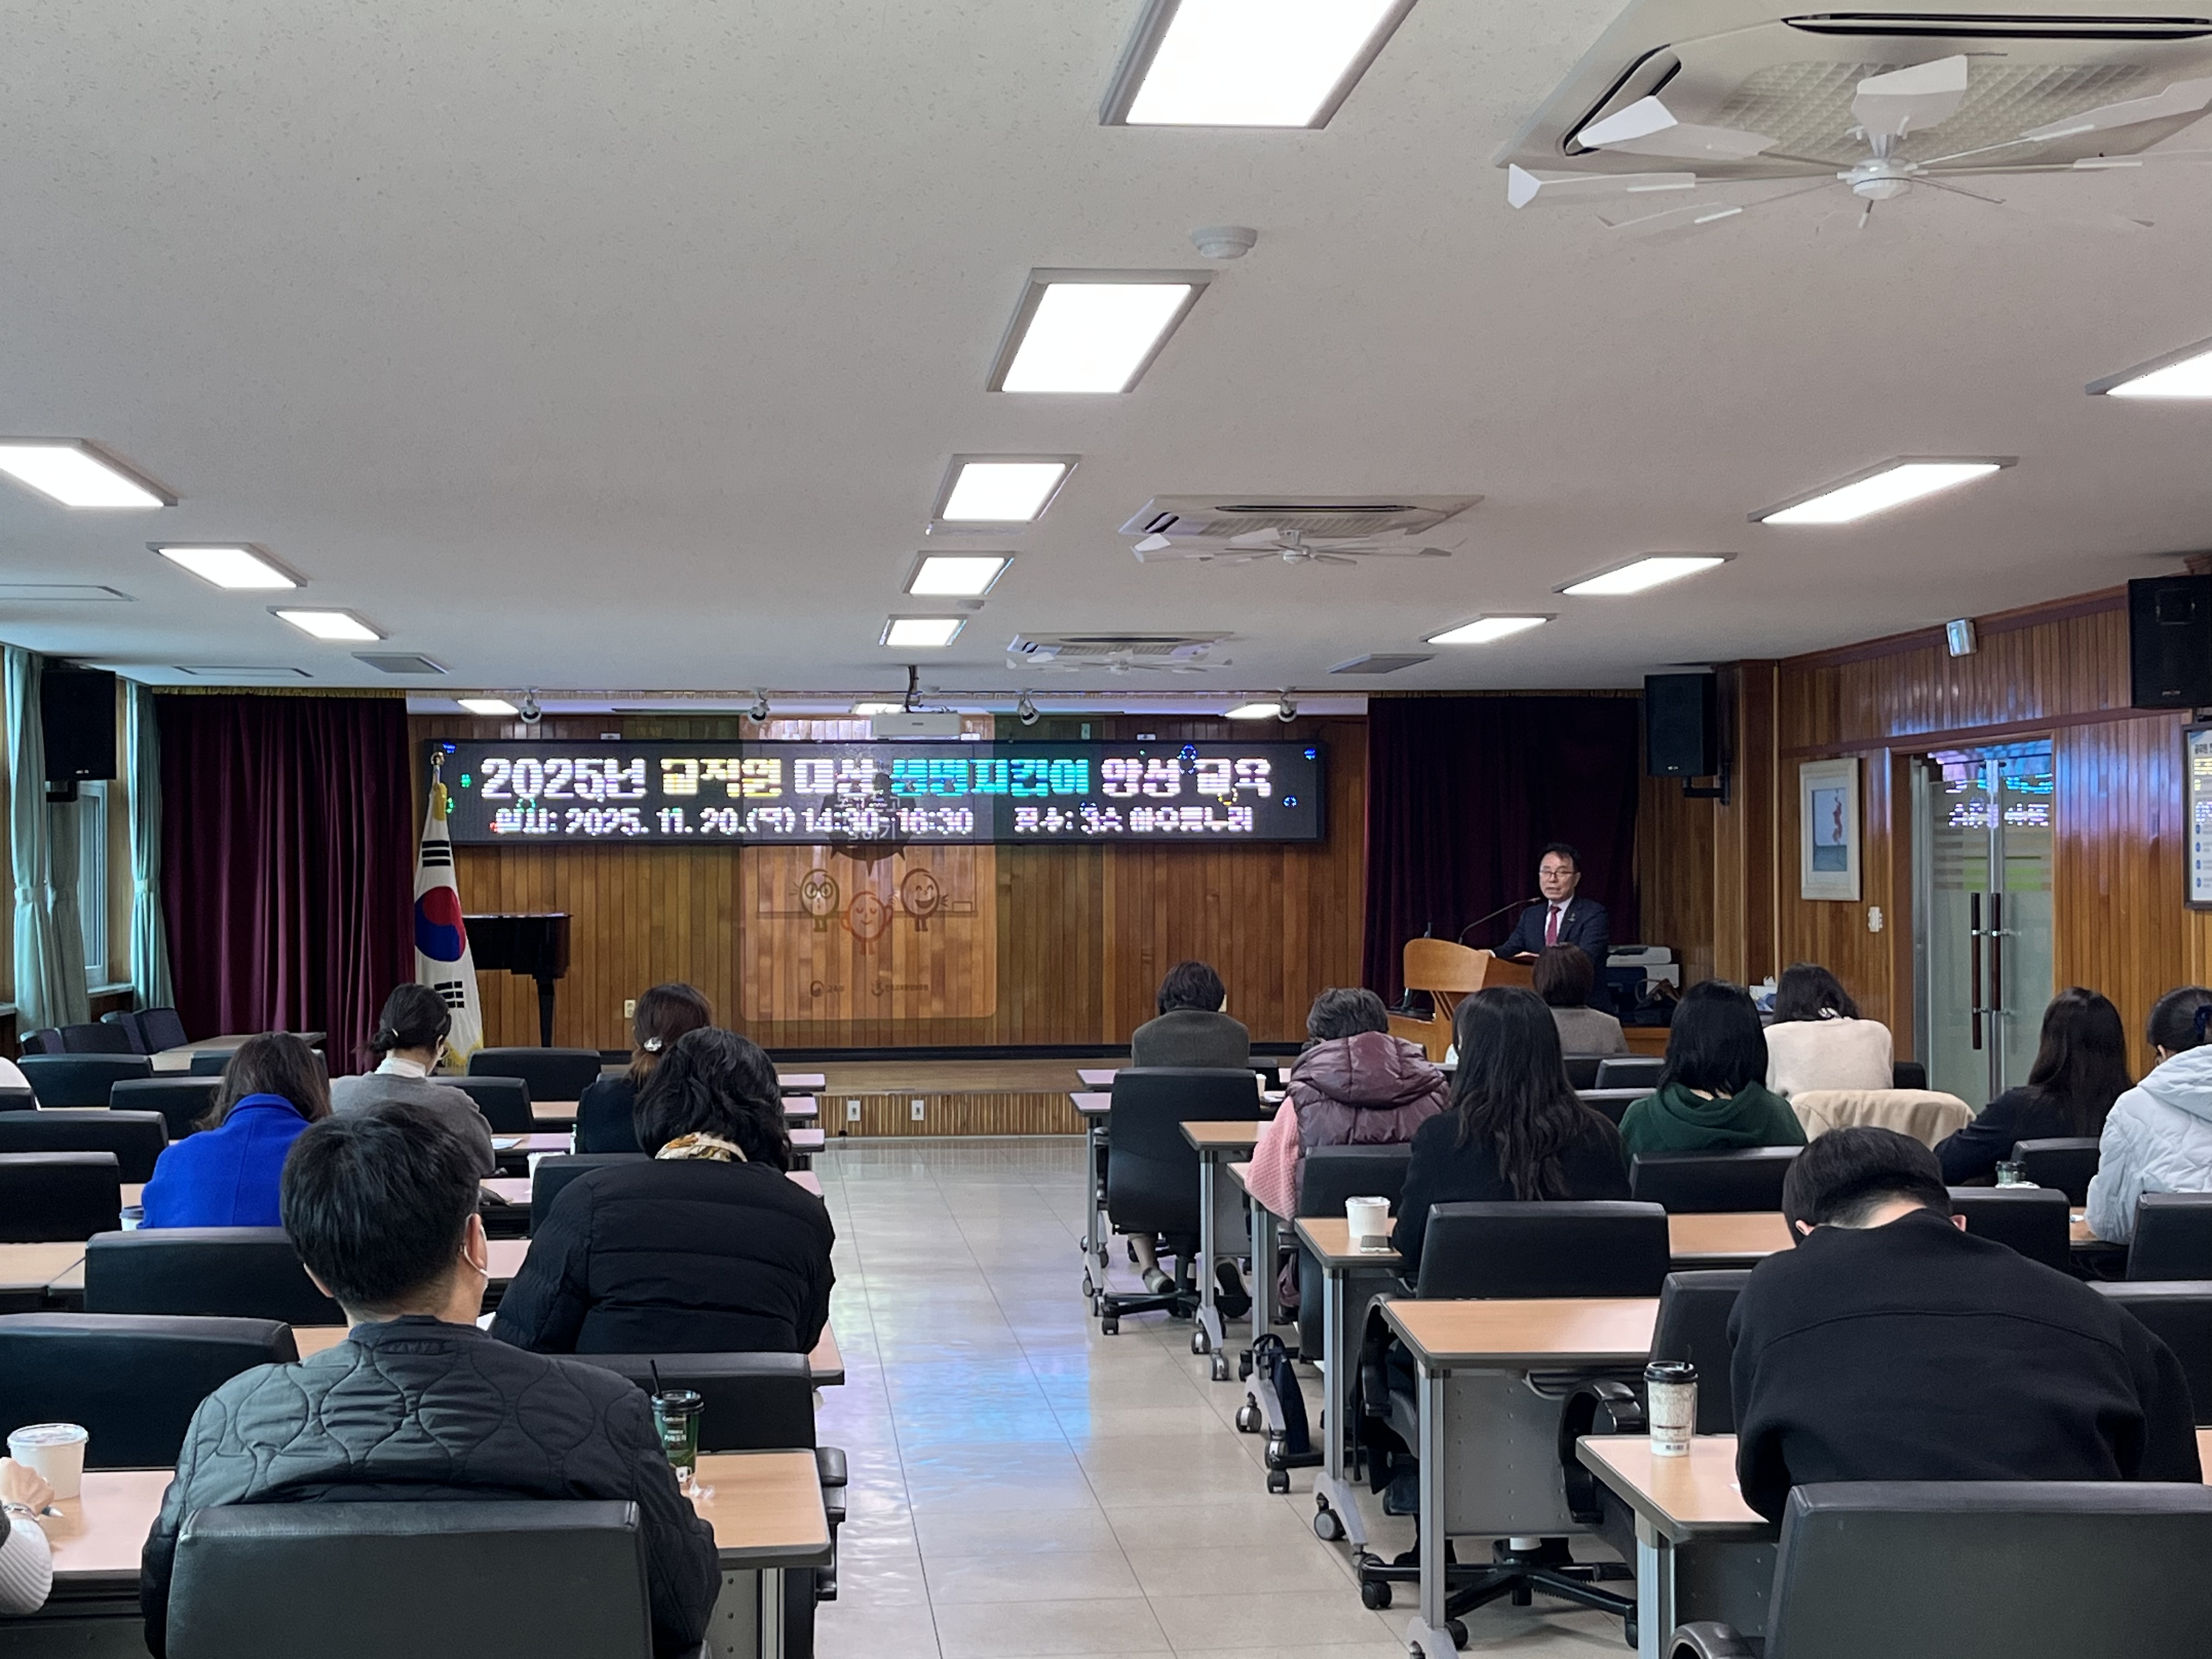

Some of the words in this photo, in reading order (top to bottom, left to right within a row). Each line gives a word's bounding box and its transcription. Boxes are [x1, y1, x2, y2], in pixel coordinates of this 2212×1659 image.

[481, 758, 646, 800] 2025년
[565, 807, 649, 836] 2025.
[656, 807, 693, 833] 11.
